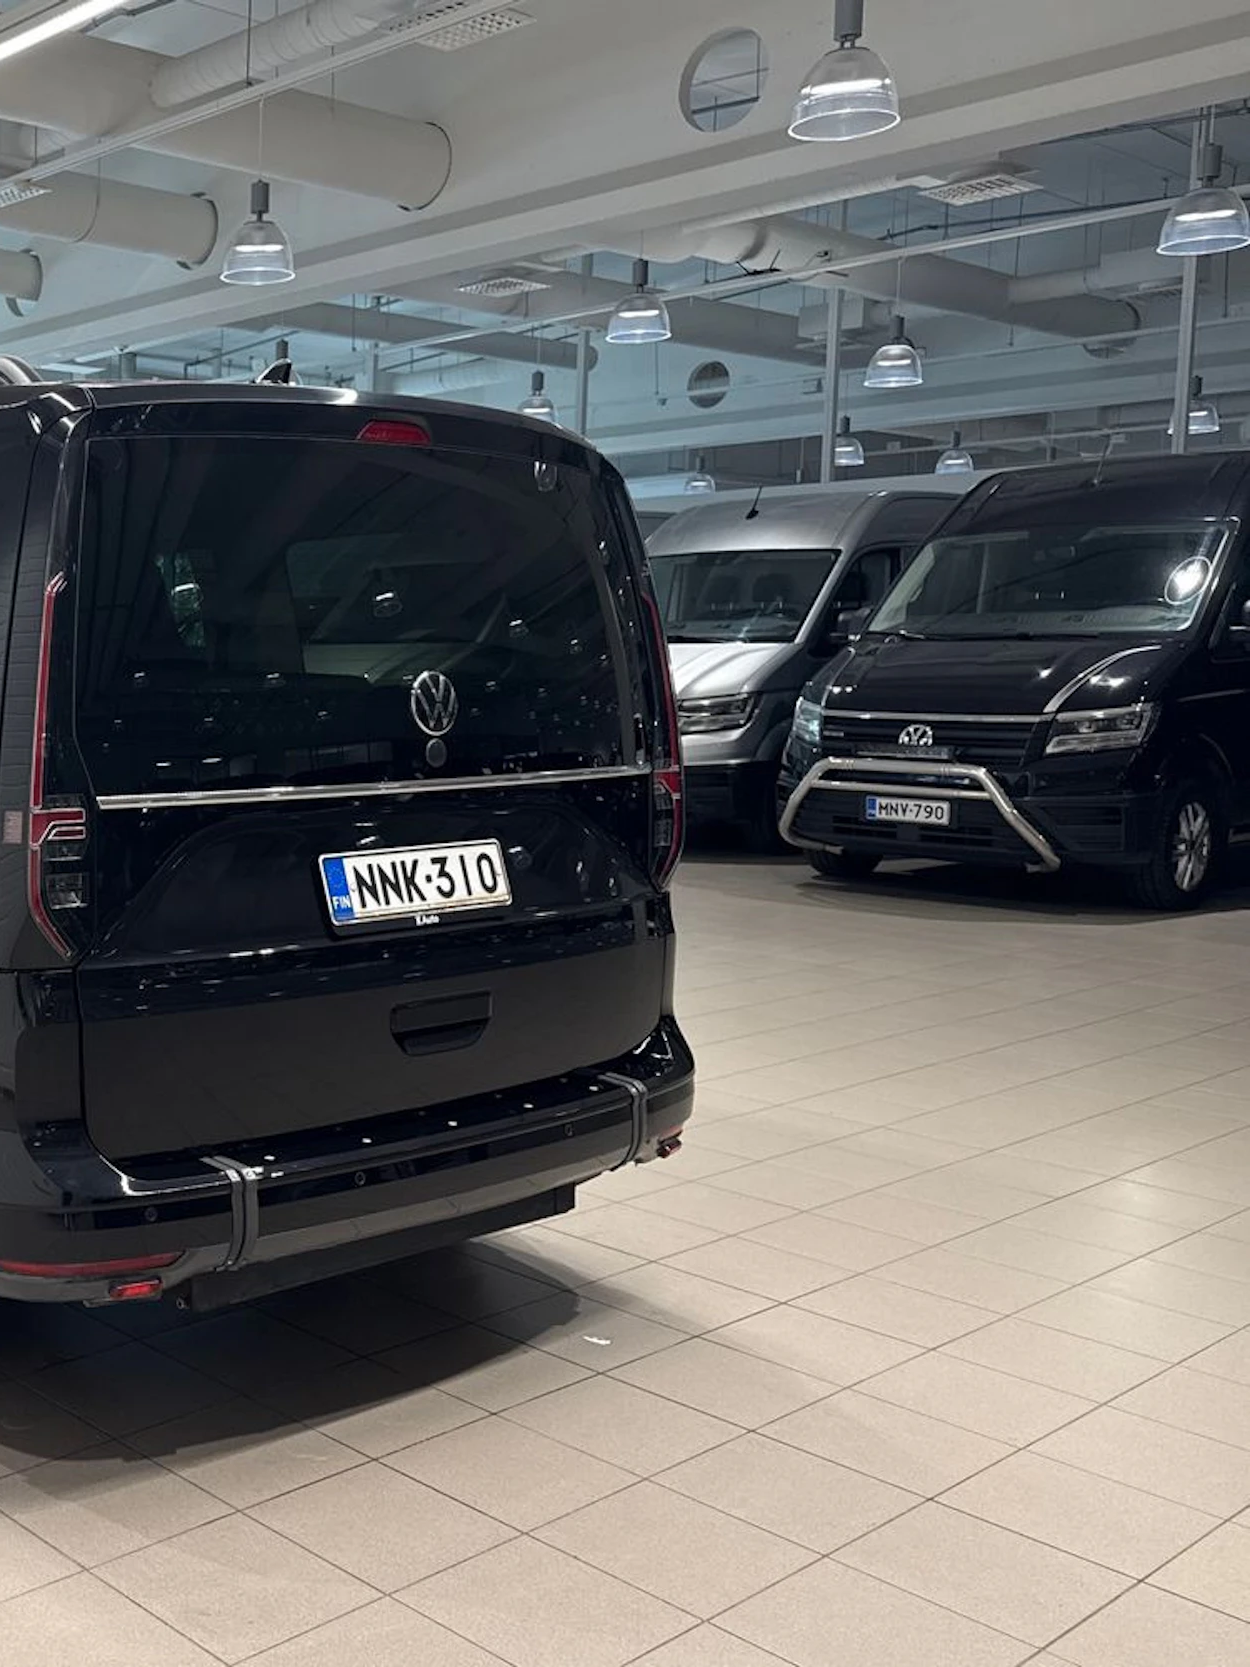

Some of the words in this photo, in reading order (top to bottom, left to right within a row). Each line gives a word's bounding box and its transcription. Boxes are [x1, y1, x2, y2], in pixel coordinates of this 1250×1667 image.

[878, 801, 945, 820] MNV-790
[353, 852, 498, 909] NNK-310
[332, 895, 352, 909] FIN
